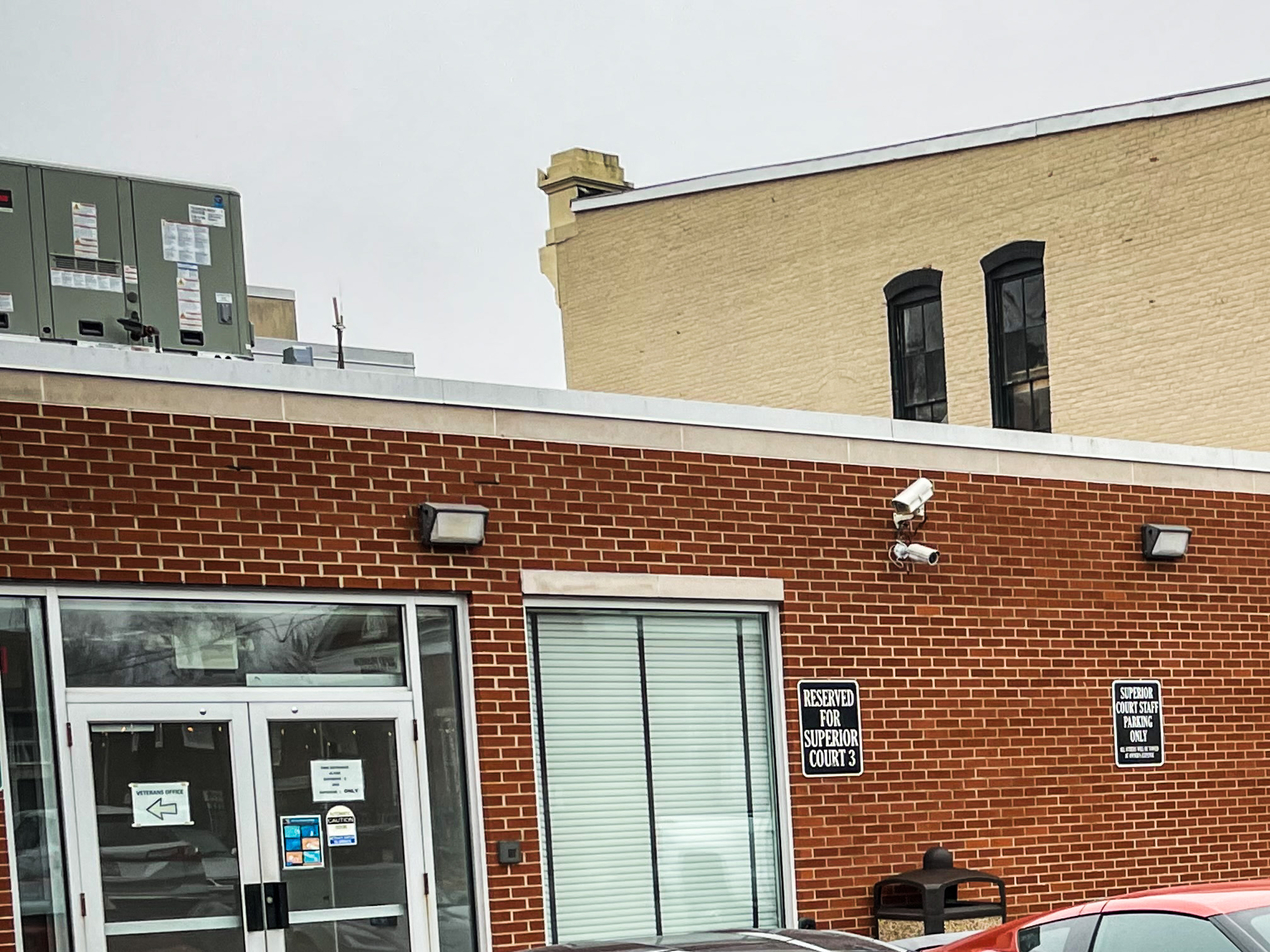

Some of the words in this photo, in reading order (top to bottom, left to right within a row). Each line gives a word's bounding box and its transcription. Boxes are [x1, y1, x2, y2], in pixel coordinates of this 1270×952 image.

[803, 689, 854, 707] RESERVED
[1120, 686, 1154, 699] SUPERIOR
[1116, 701, 1139, 714] COURT
[1139, 701, 1159, 714] STAFF
[819, 710, 841, 727] FOR
[1123, 715, 1153, 728] PARKING
[804, 729, 859, 748] SUPERIOR
[1130, 729, 1148, 742] ONLY
[809, 749, 847, 768] COURT
[847, 749, 857, 767] 3
